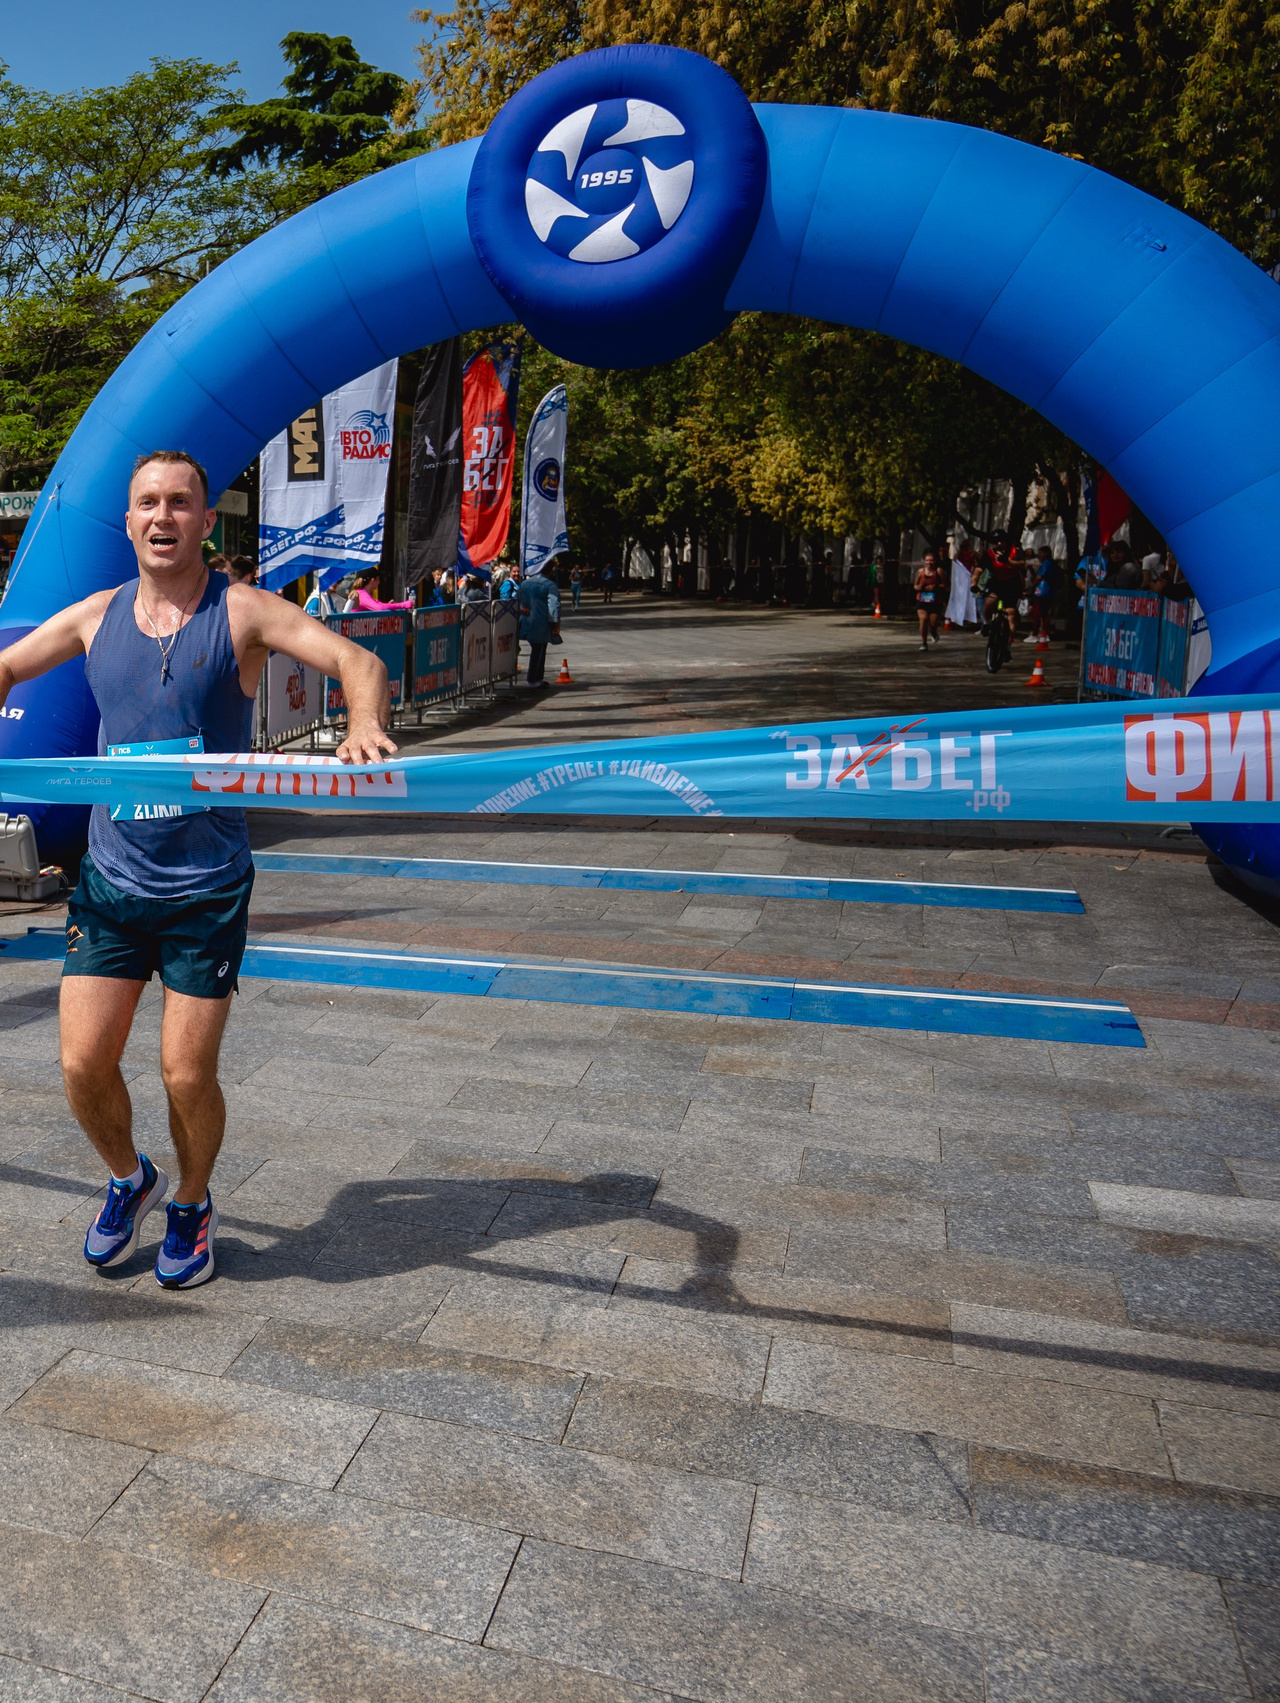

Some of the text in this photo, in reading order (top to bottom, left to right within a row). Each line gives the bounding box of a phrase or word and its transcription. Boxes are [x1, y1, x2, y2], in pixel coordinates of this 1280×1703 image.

[581, 168, 634, 189] 1995
[74, 777, 112, 785] ГЕРОЕВ
[538, 760, 605, 792] #ТРЕПЕТ
[608, 759, 716, 814] #УДИВЛЕНИЕ
